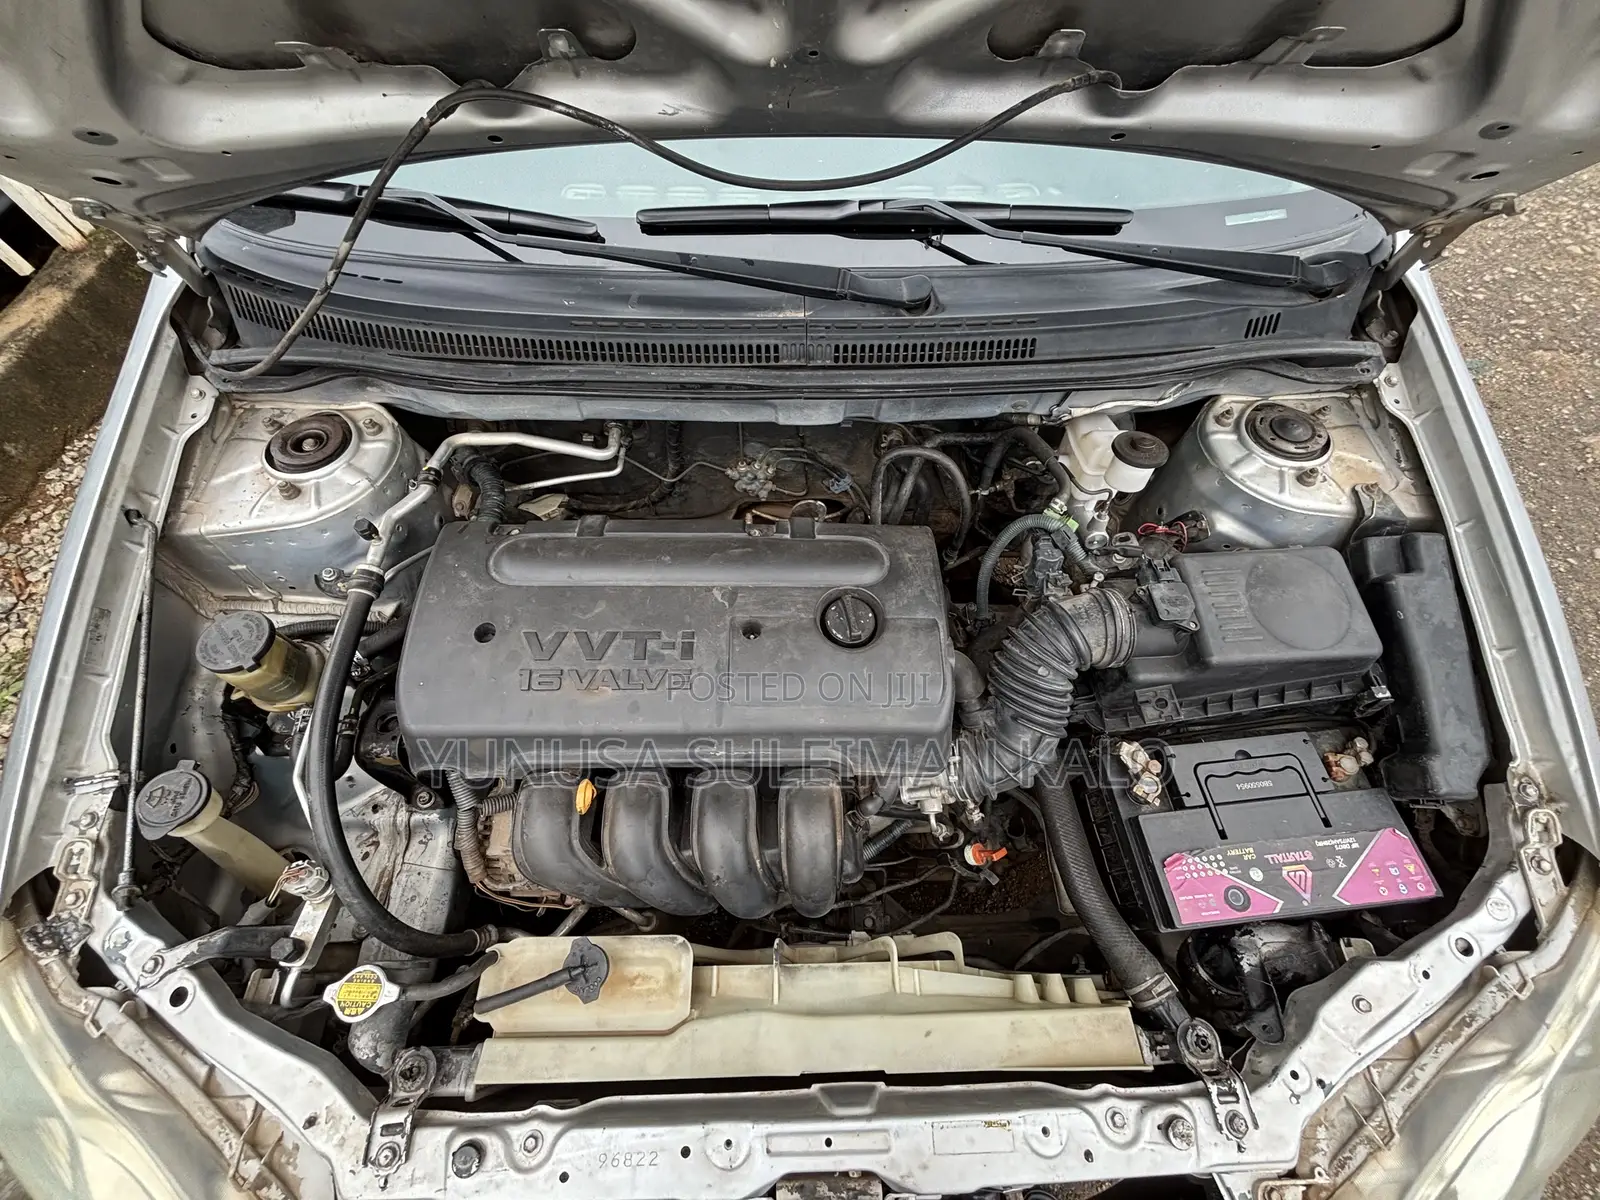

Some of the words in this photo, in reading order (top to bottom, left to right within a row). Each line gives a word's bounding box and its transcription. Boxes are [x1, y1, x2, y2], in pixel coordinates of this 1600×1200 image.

[522, 630, 696, 661] VVT-i
[519, 669, 563, 691] 16
[568, 669, 693, 691] VALVE
[1227, 847, 1255, 856] BATTERY
[1263, 850, 1314, 864] STARTALL
[340, 1000, 372, 1008] CAUTION
[598, 1150, 659, 1169] 96822
